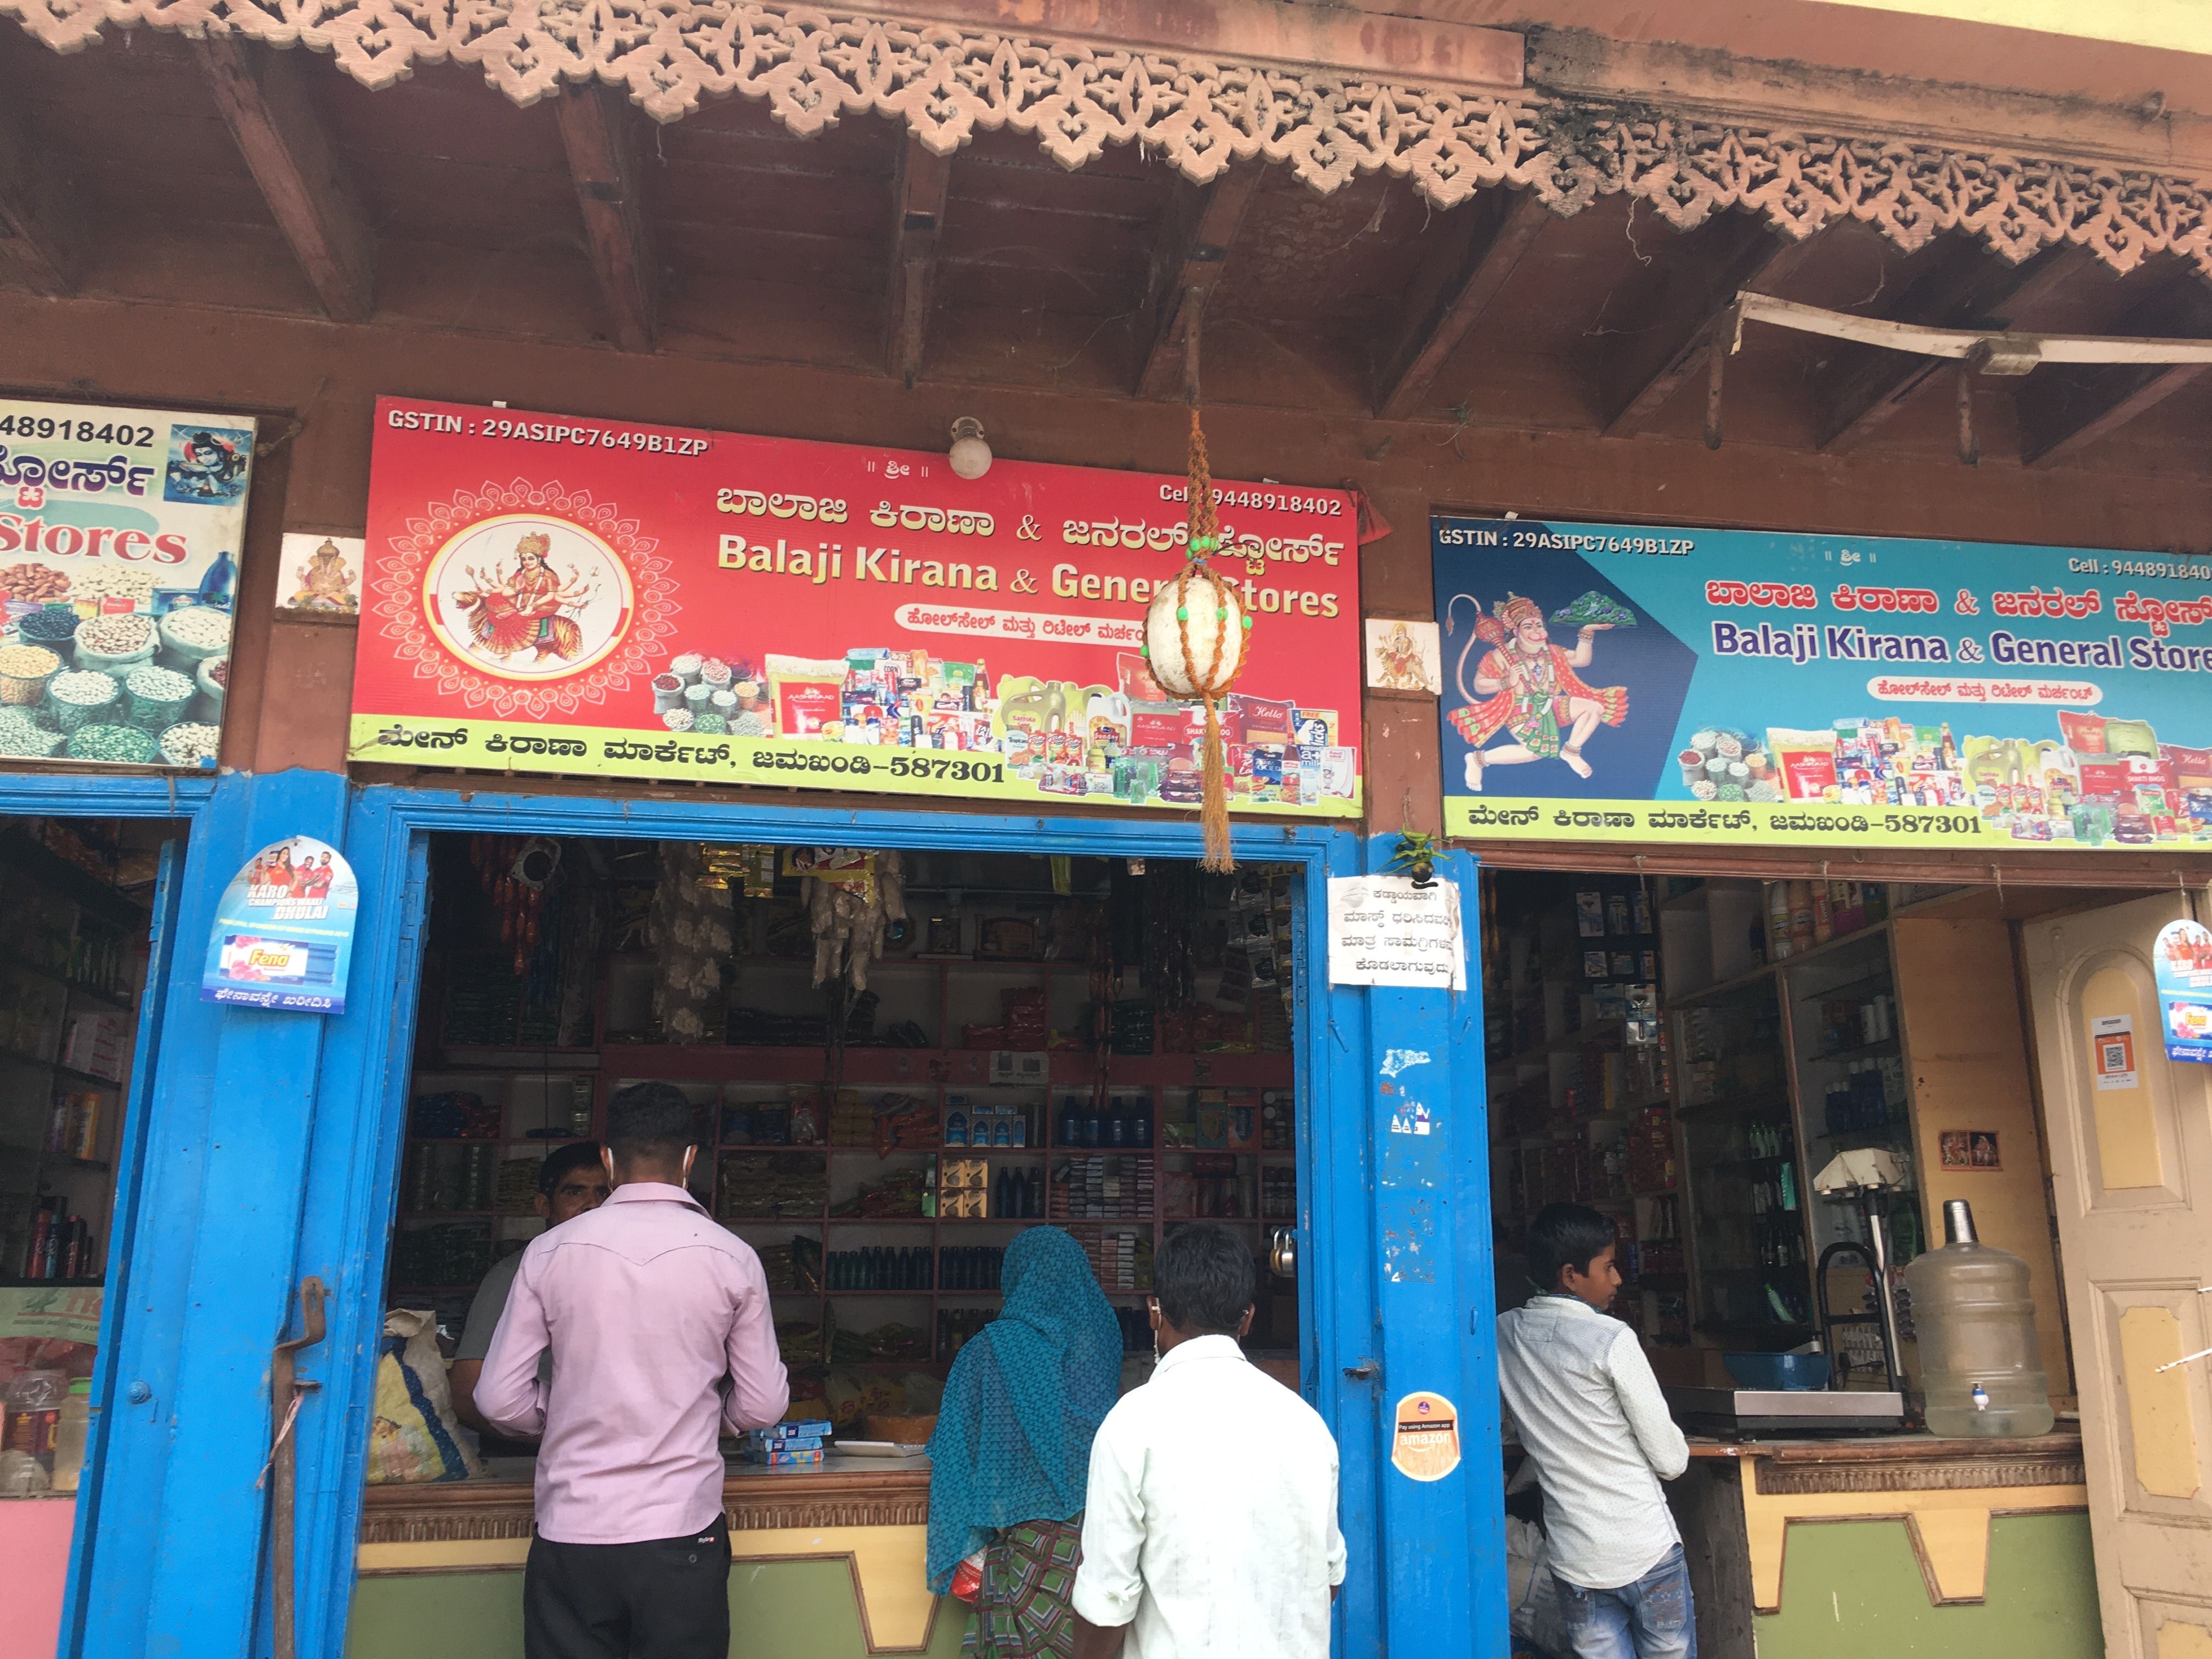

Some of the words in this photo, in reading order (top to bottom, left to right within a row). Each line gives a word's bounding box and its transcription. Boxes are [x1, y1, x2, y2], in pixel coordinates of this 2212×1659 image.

[388, 410, 462, 433] GSTIN
[481, 418, 708, 456] 29ASIPC7649B1ZP
[1159, 484, 1189, 503] Cel
[1211, 488, 1342, 516] 9448918402
[716, 488, 849, 524] ಬಾಲಾಜಿ
[870, 500, 995, 537] ಕಿರಾಣಾ
[1017, 514, 1042, 541] &
[1062, 515, 1189, 552] ಜನರಲ್
[0, 513, 187, 564] Stores
[1440, 528, 1498, 547] GSTIN
[1513, 532, 1695, 556] 29ASIPC7649B1ZP
[718, 534, 842, 585] Balaji
[855, 546, 998, 592] Kirana
[1009, 569, 1039, 595] &
[1052, 563, 1200, 604] Gener
[1220, 576, 1339, 619] tores
[2068, 557, 2099, 574] Cell
[2112, 560, 2212, 580] 944891840
[1706, 580, 1817, 609] ಬಾಲಾಜಿ
[1832, 584, 1939, 613] ಕಿರಾಣಾ
[1955, 589, 1979, 614] &
[1993, 586, 2101, 618] ಜನರಲ್
[1002, 611, 1036, 639] ಮತ್ತು
[1713, 622, 1818, 663] Balaji
[1826, 627, 1950, 661] Kirana
[1958, 639, 1984, 662] &
[1990, 631, 2123, 668] General
[1252, 705, 1284, 720] Hello
[379, 724, 468, 750] ಮೇನ್
[484, 733, 587, 758] ಕಿರಾಣಾ
[1468, 804, 1539, 826] ಮೇನ್
[1553, 808, 1635, 828] ಕಿರಾಣಾ
[246, 884, 289, 899] KARO
[272, 905, 329, 920] DHULAI
[1341, 934, 1376, 950] ಮಾತ್ರ
[249, 949, 290, 967] Fena
[1400, 1432, 1451, 1446] amazon
